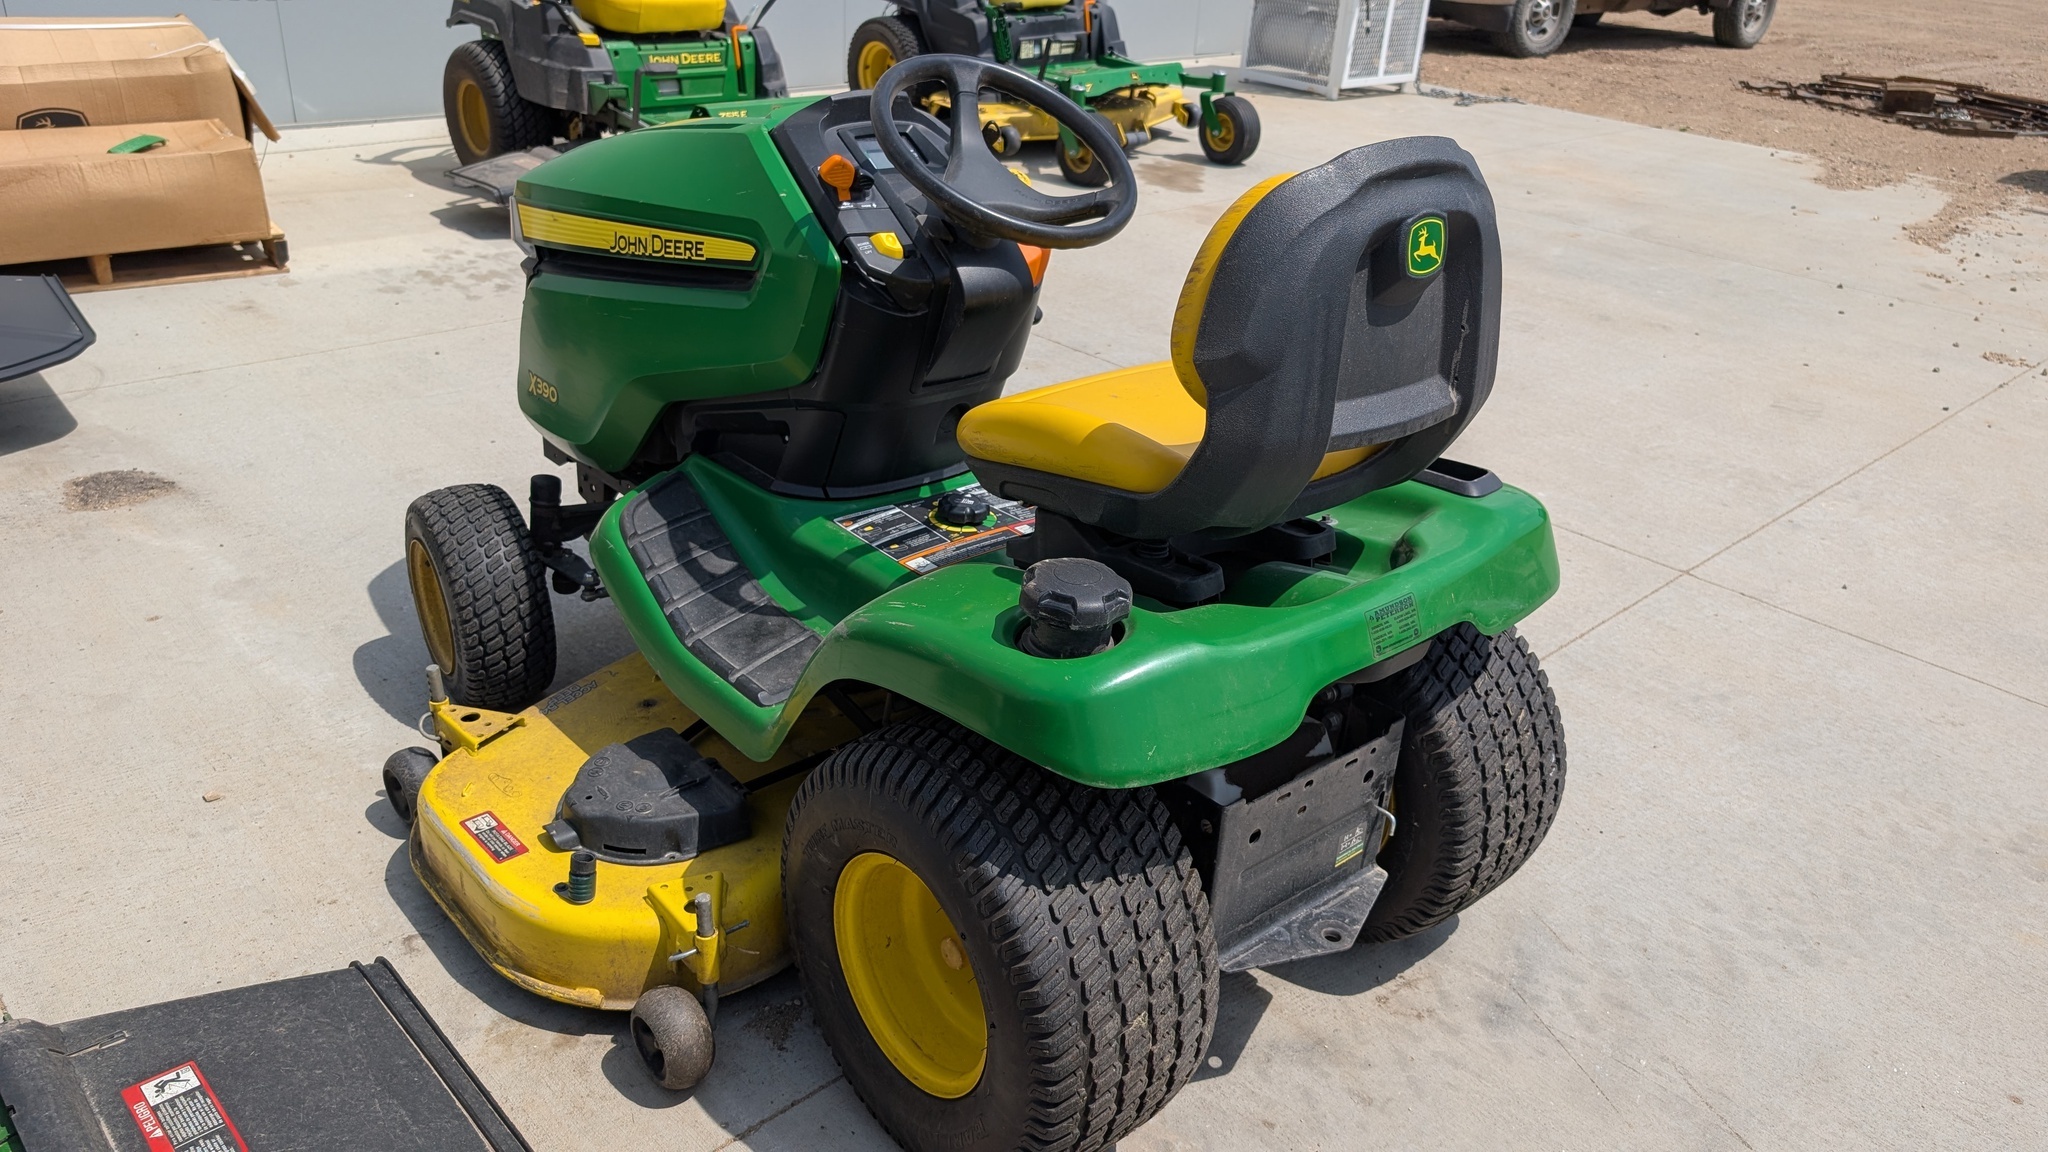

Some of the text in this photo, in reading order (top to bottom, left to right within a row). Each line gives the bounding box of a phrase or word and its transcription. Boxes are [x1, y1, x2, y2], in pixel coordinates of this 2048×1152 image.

[681, 52, 722, 64] DEERE
[609, 231, 706, 260] JOHN DEERE
[528, 369, 559, 403] X390
[133, 1101, 156, 1133] PELIGRO
